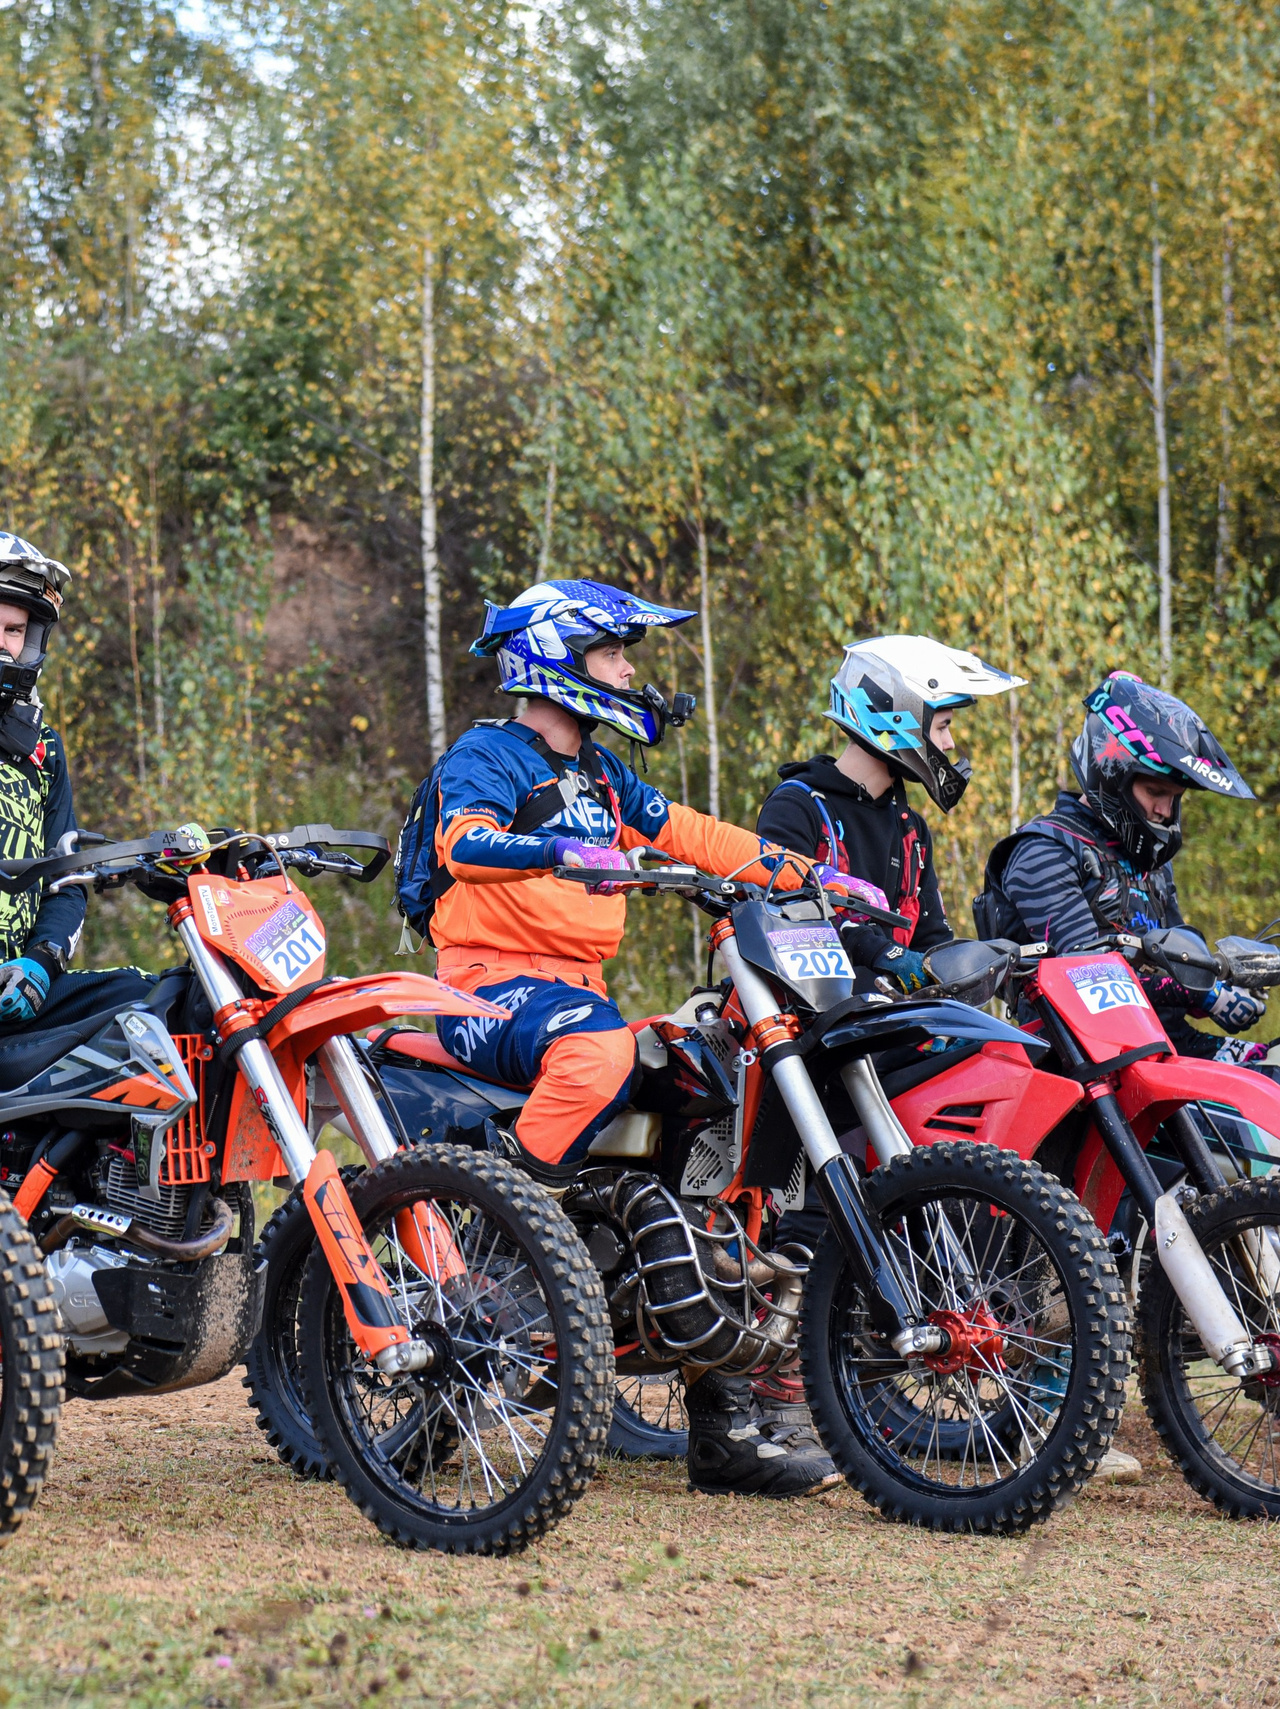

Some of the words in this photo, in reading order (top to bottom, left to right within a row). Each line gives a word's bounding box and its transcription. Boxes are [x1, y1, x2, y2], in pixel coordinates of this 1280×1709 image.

[1179, 754, 1233, 791] AIROH
[243, 901, 301, 955] MOTOFEST
[767, 928, 840, 946] MOTOFEST
[272, 927, 324, 980] 201
[789, 950, 849, 978] 202
[1089, 982, 1140, 1010] 207
